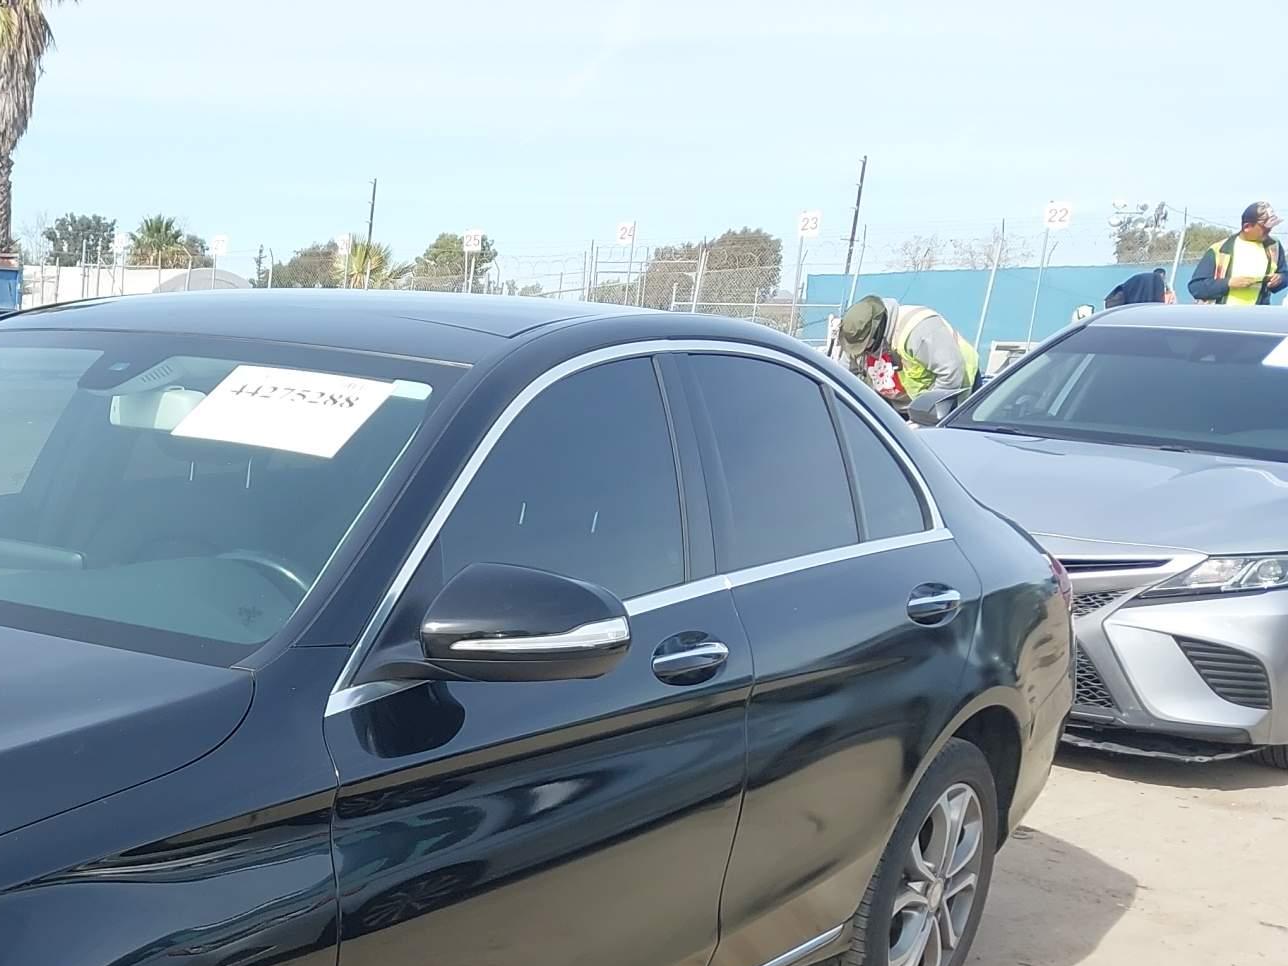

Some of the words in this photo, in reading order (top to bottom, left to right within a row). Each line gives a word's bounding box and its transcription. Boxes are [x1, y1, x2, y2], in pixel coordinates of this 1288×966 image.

[1048, 207, 1069, 223] 22
[801, 216, 818, 231] 23
[465, 233, 480, 247] 25
[230, 384, 360, 408] 44275288
